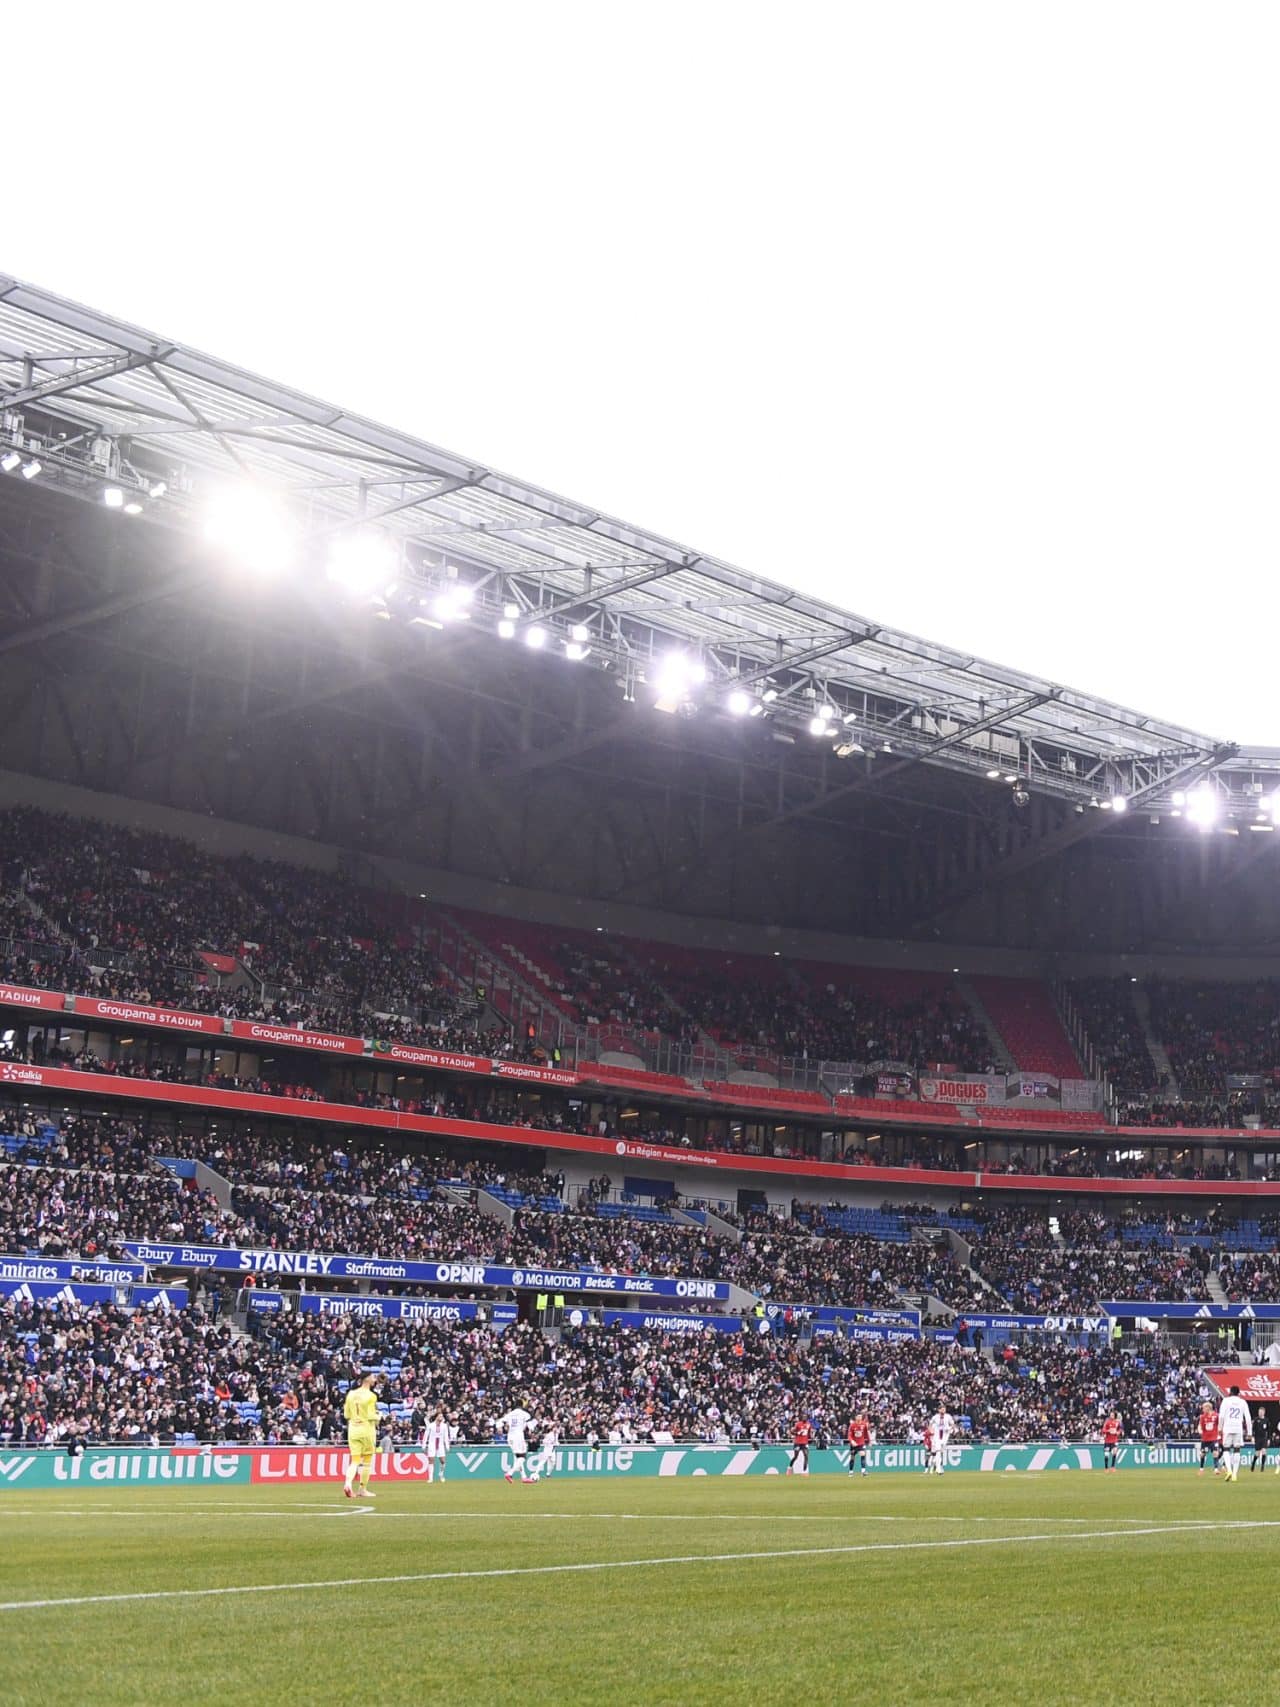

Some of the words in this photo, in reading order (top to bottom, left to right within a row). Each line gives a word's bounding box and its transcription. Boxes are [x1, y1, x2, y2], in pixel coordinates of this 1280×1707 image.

[0, 990, 41, 1005] TADIUM
[97, 1003, 156, 1022] Groupama
[159, 1014, 202, 1028] STADIUM
[251, 1025, 304, 1043] Groupama
[306, 1036, 345, 1049] STADIUM
[391, 1047, 438, 1063] Groupama
[440, 1056, 475, 1069] STADIUM
[18, 1070, 42, 1080] dalkia
[498, 1063, 541, 1079] Groupama
[543, 1072, 576, 1083] STADIUM
[940, 1082, 987, 1098] DOGUES
[626, 1146, 636, 1154] La
[137, 1246, 174, 1265] Ebury
[181, 1249, 217, 1266] Ebury
[71, 1265, 133, 1284] Emirates
[345, 1262, 406, 1278] Staffmatch
[525, 1273, 543, 1286] MG
[544, 1275, 581, 1288] MOTOR
[585, 1276, 616, 1290] Betclic
[624, 1279, 654, 1292] Betclic
[319, 1297, 383, 1317] Emirates
[400, 1302, 461, 1320] Emirates
[992, 1319, 1019, 1328] Emirates
[1229, 1407, 1241, 1420] 22
[259, 1454, 428, 1478] Emirtes
